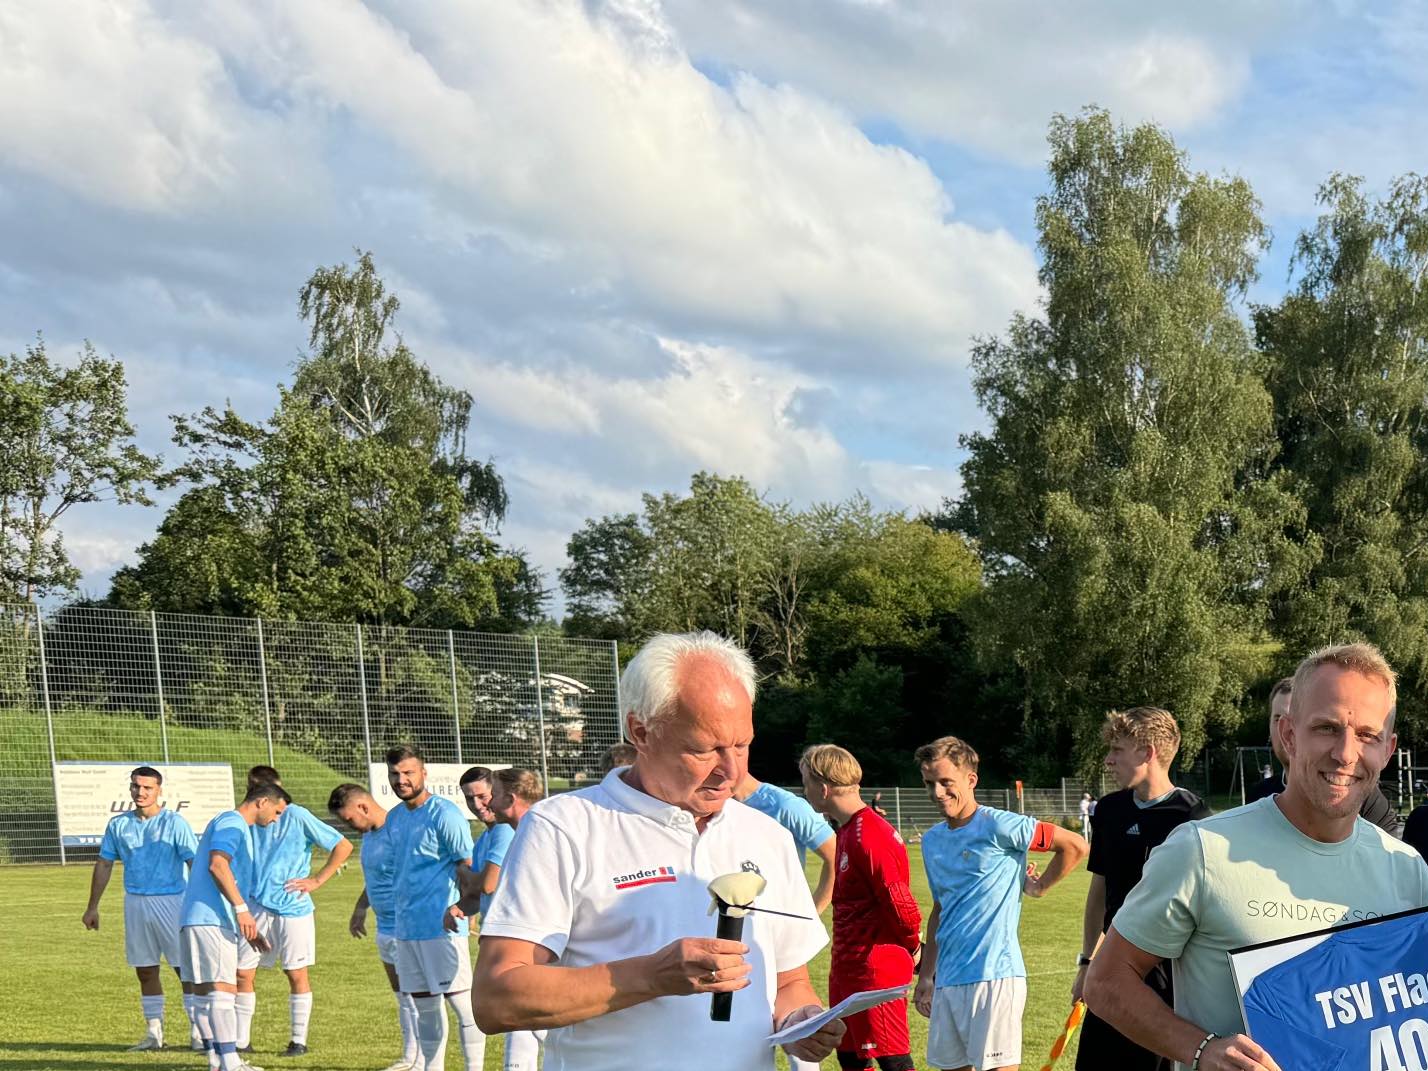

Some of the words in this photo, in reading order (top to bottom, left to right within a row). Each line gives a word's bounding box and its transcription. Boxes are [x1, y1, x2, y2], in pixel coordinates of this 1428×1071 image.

[612, 869, 657, 884] sander
[1247, 899, 1337, 924] SØNDAG
[1341, 911, 1350, 922] &
[1352, 909, 1385, 924] SO
[1315, 981, 1374, 1029] TSV
